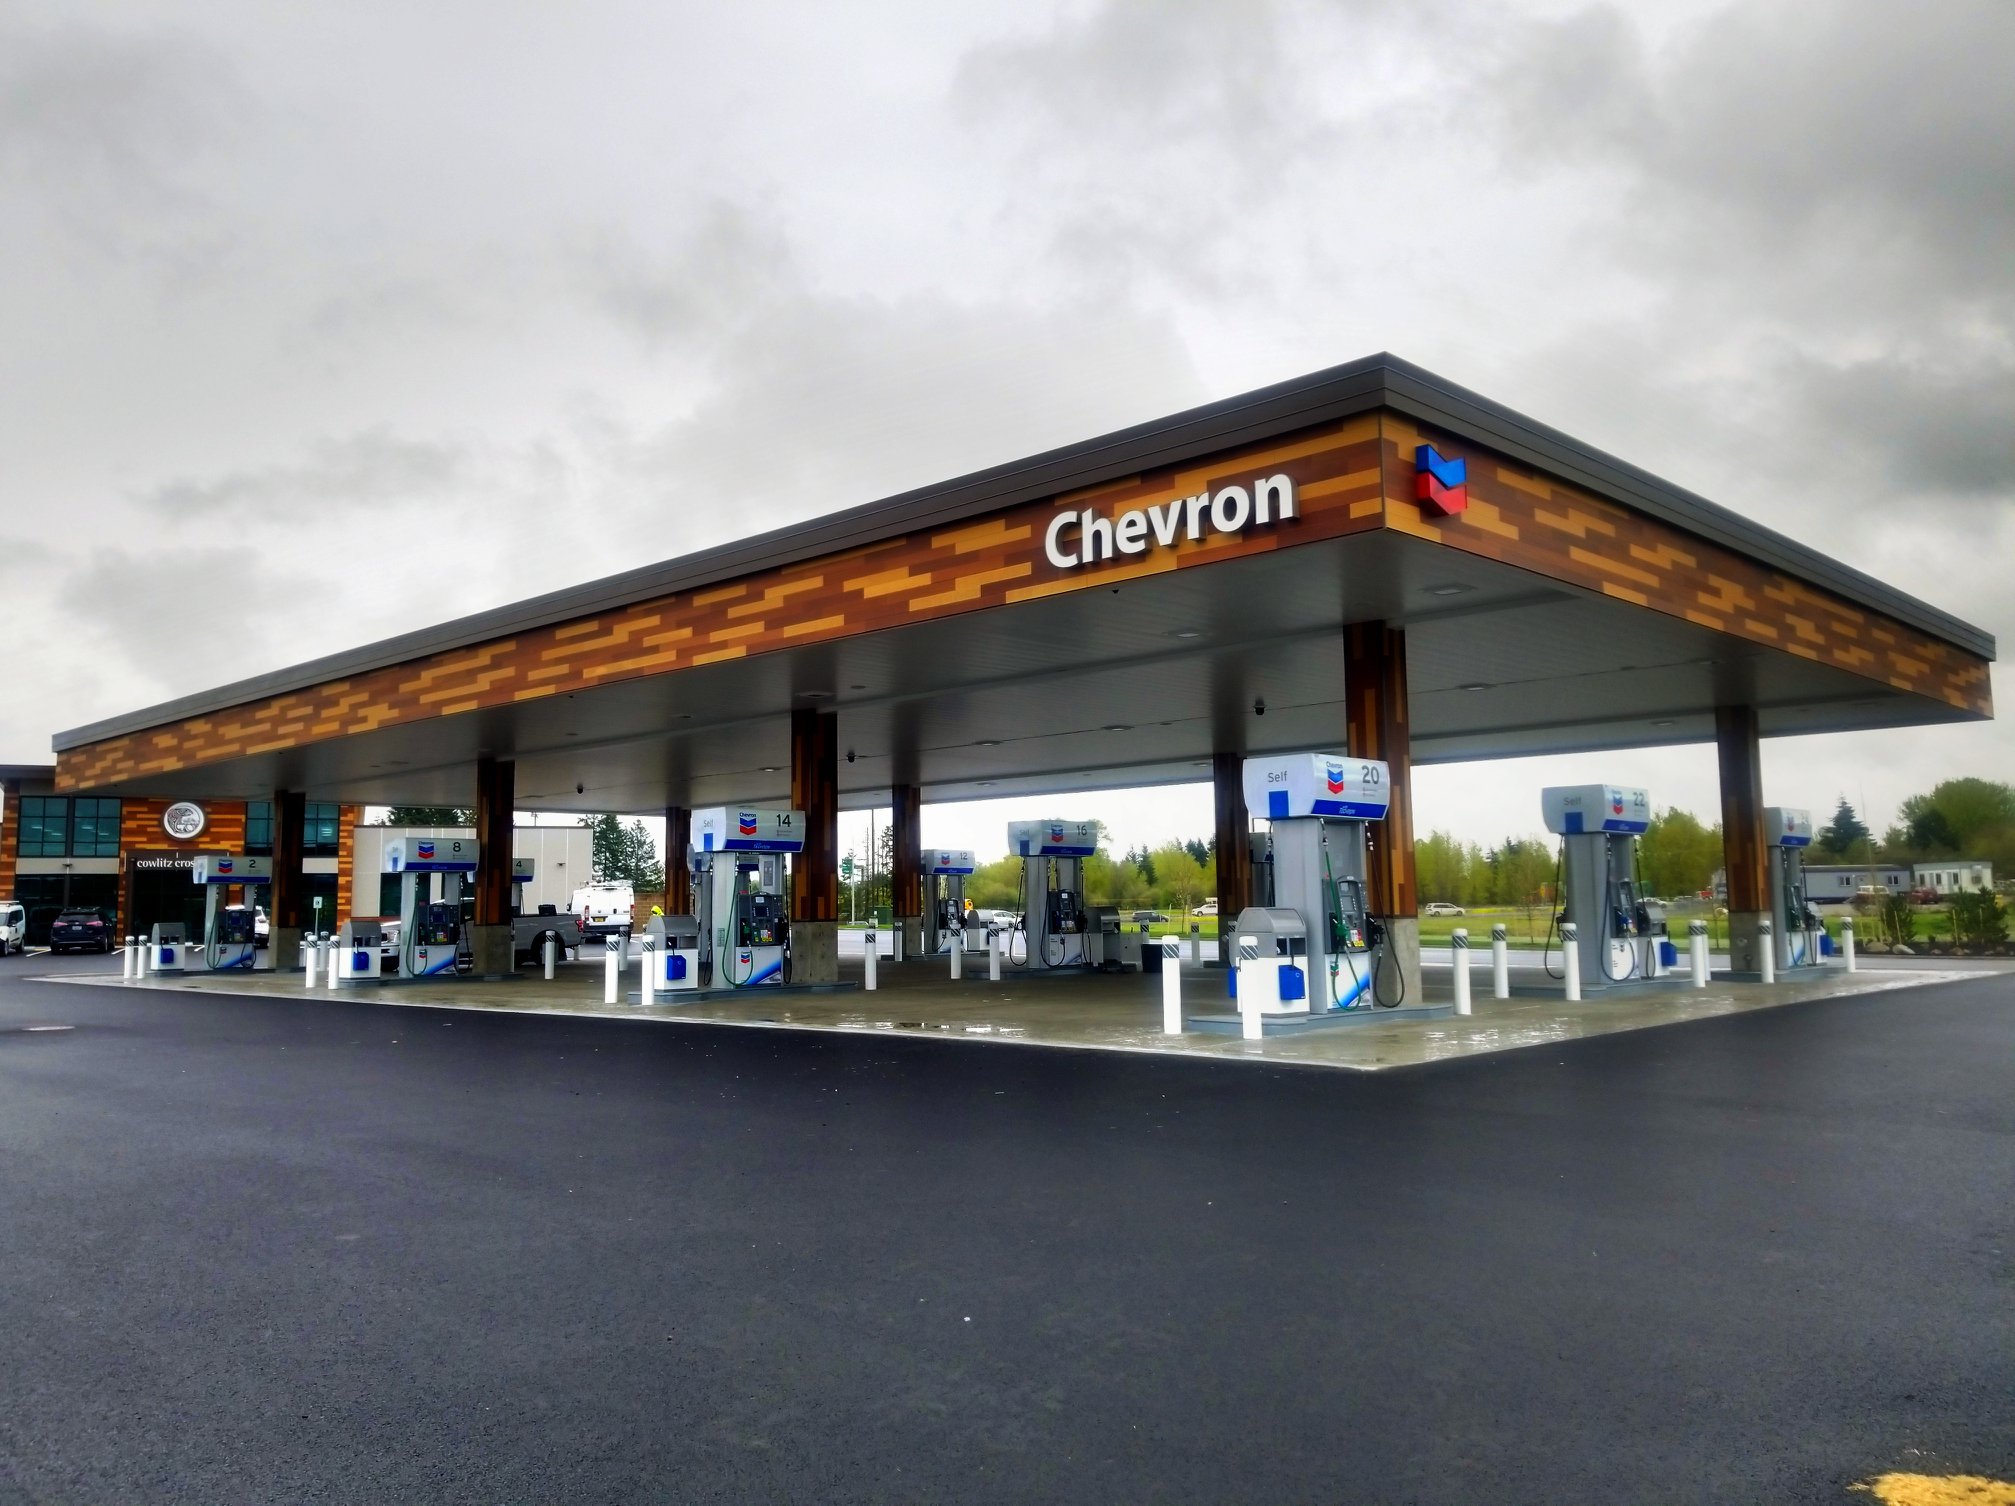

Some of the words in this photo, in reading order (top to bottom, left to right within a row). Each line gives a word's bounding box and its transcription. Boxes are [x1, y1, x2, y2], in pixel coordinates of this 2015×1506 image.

[1045, 473, 1295, 569] Chevron
[1267, 771, 1288, 783] Self
[1361, 765, 1379, 785] 20
[1563, 797, 1582, 806] Self
[1633, 792, 1645, 807] 22
[776, 813, 792, 828] 14
[1076, 824, 1088, 836] 16
[452, 841, 462, 852] 8
[960, 852, 968, 860] 12
[136, 858, 173, 868] cowlitz
[248, 859, 256, 869] 2
[515, 860, 522, 868] 4
